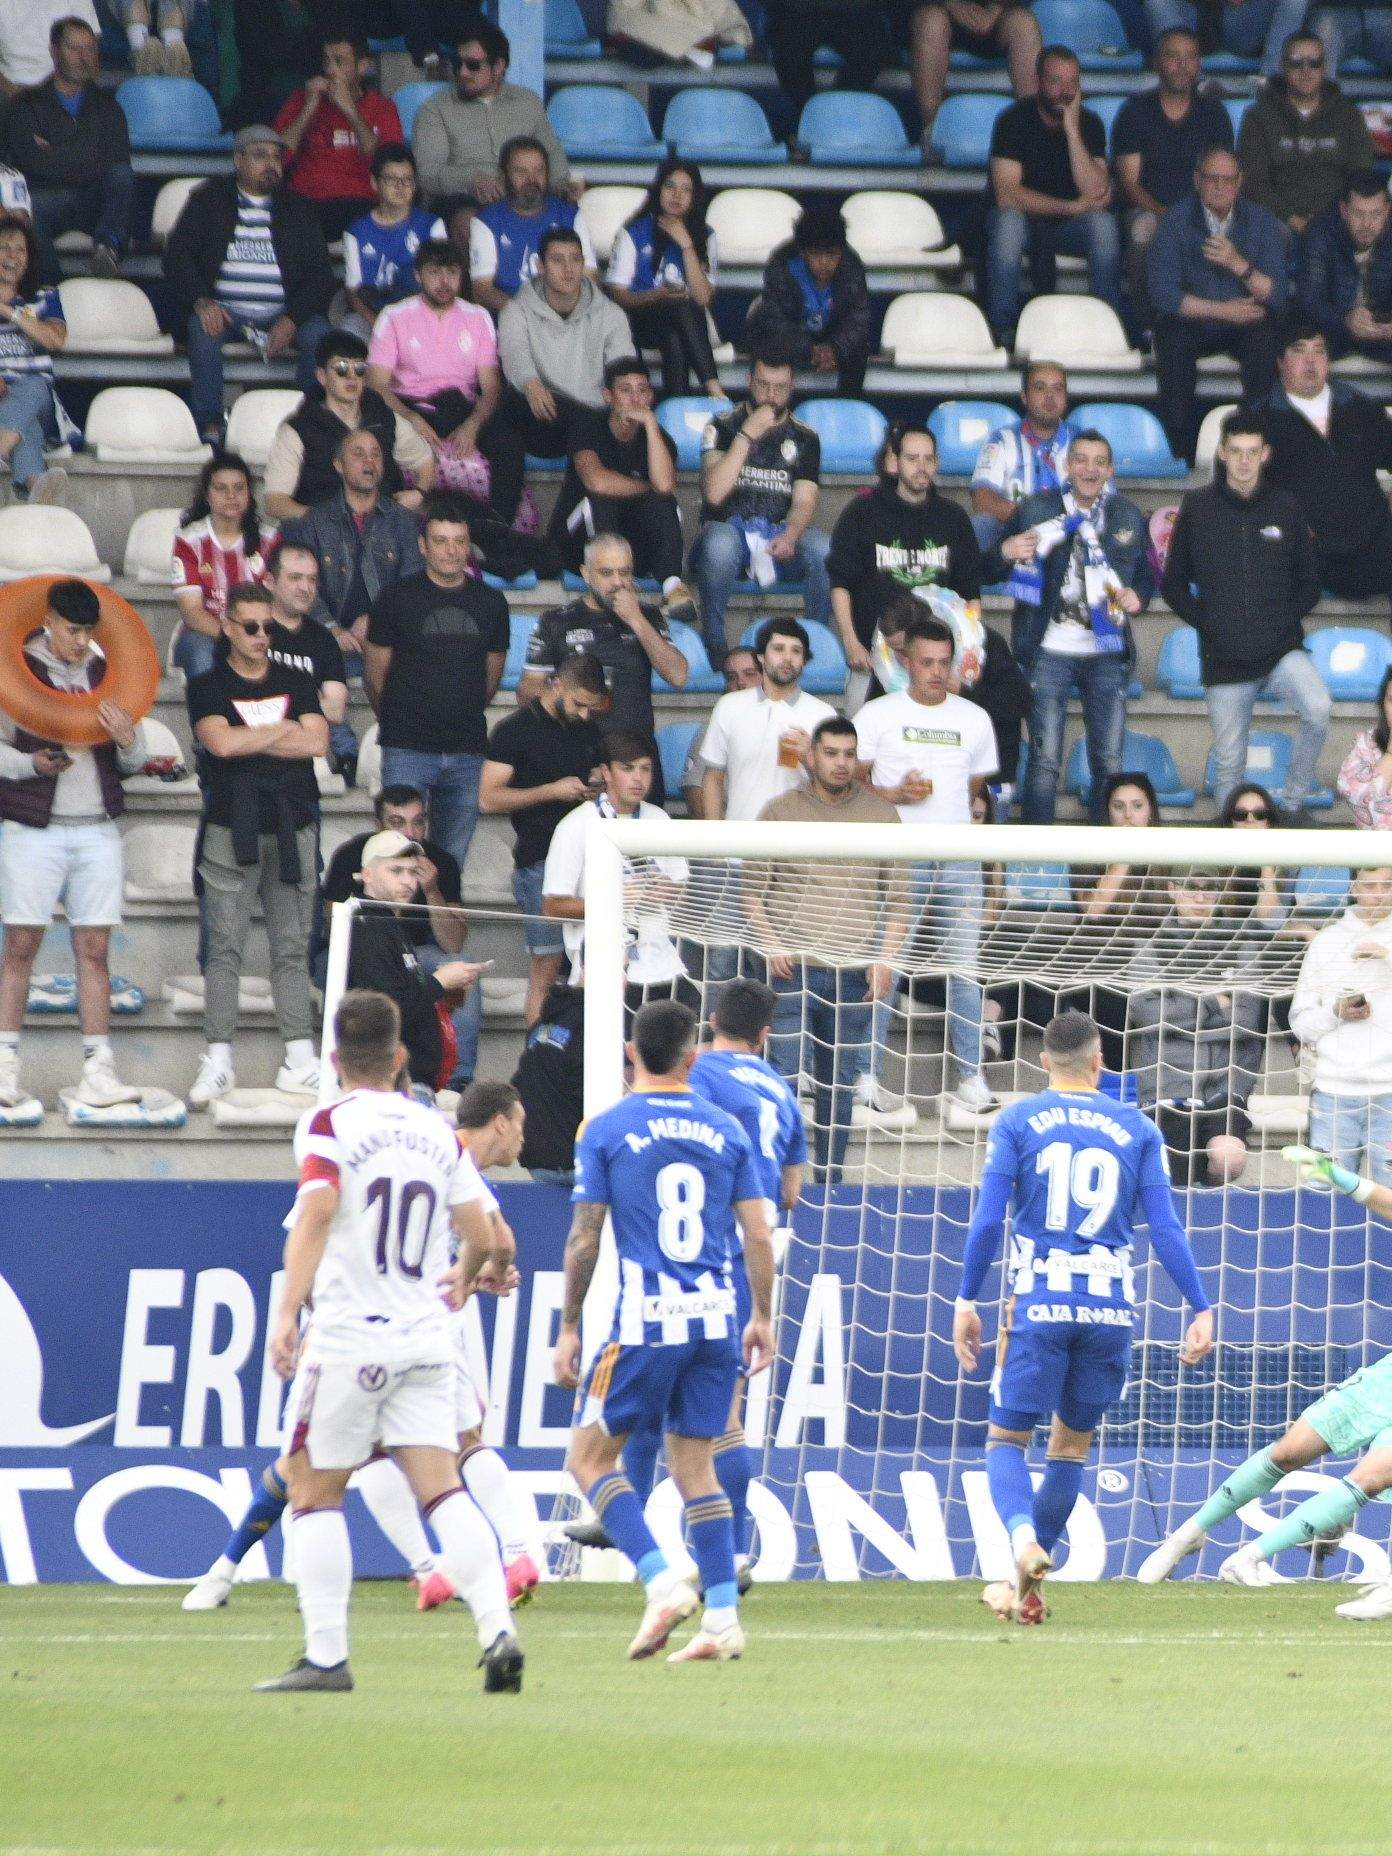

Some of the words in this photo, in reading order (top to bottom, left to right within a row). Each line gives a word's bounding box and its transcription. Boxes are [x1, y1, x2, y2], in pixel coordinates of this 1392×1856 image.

[647, 1117, 725, 1153] MEDINA
[1028, 1107, 1066, 1135] EDU
[655, 1162, 706, 1263] 8
[1035, 1141, 1120, 1239] 19
[364, 1177, 437, 1283] 10
[1027, 1304, 1073, 1323] CAJA
